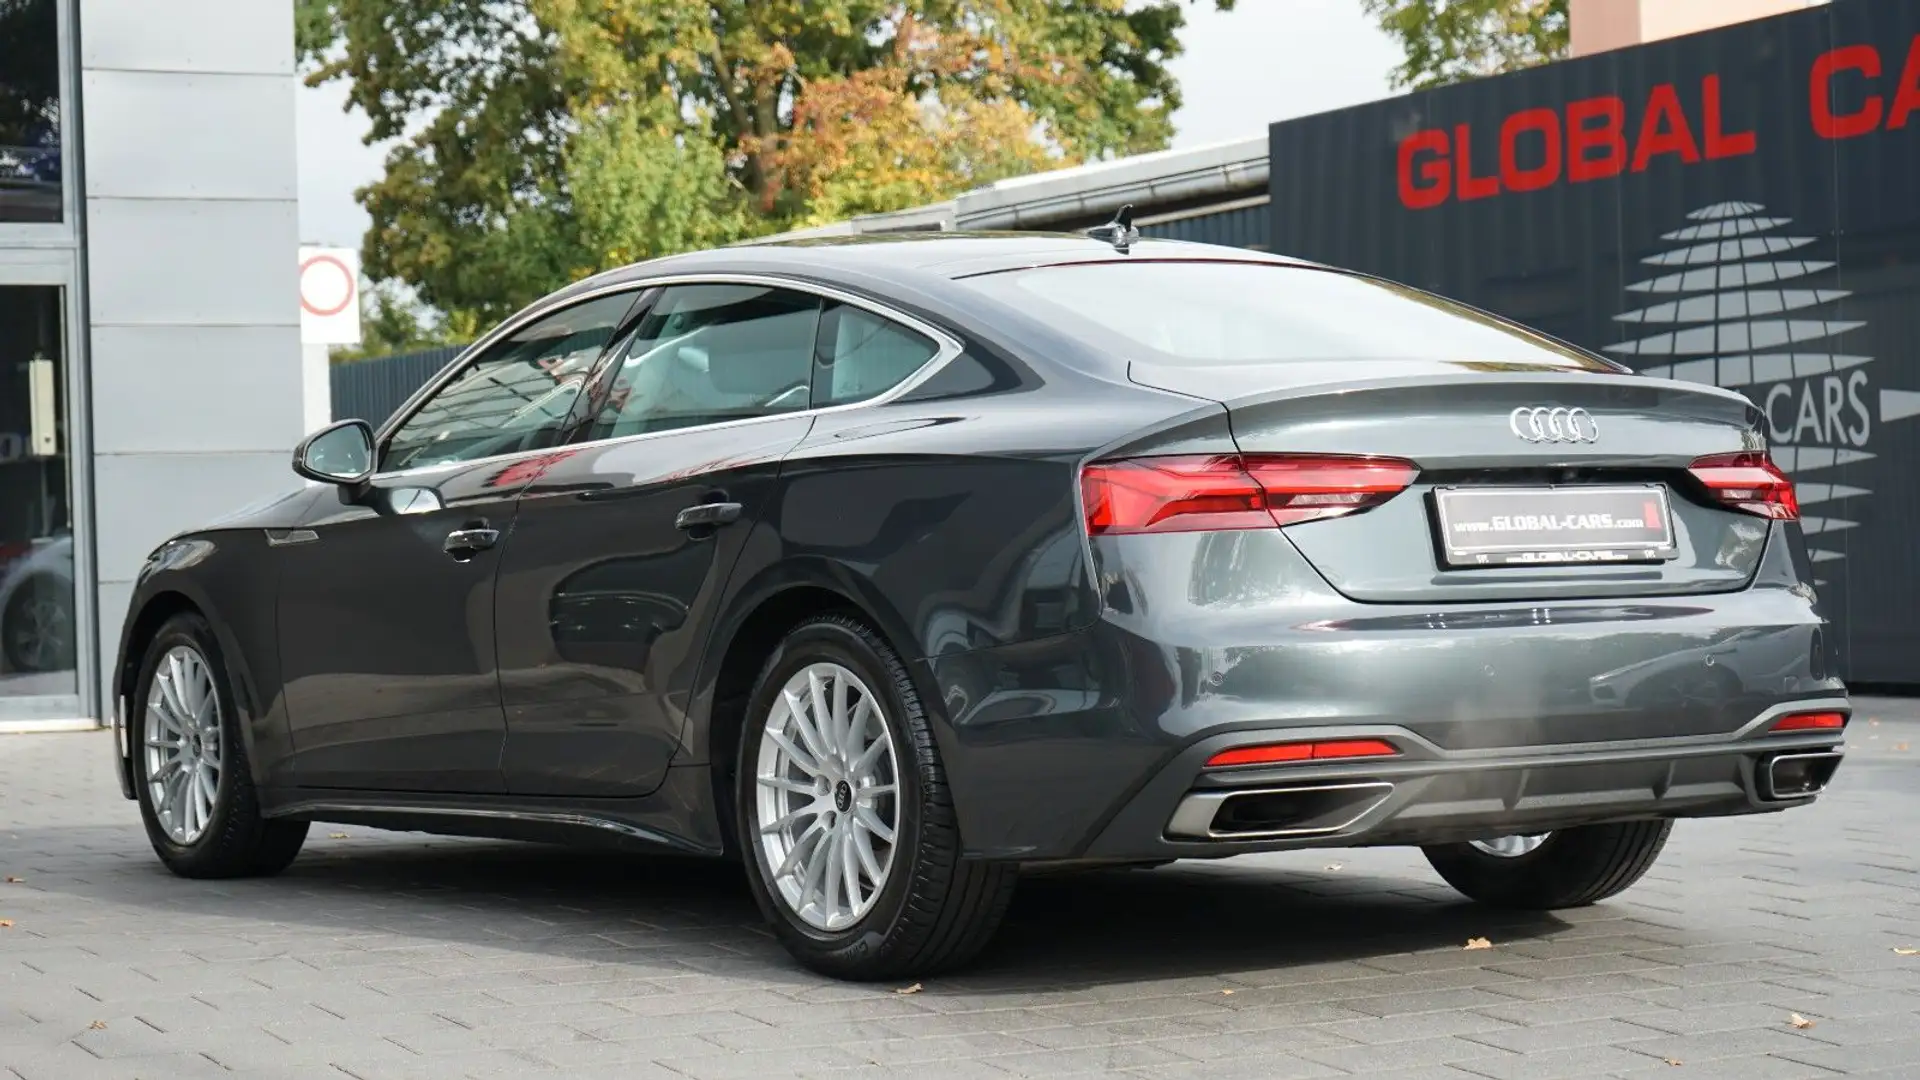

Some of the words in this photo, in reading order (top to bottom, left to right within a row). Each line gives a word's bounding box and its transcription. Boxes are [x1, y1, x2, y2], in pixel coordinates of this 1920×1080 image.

[1397, 74, 1757, 209] GLOBAL
[1765, 370, 1870, 447] CARS
[1453, 514, 1645, 532] www.GLOBAL-CARS.com
